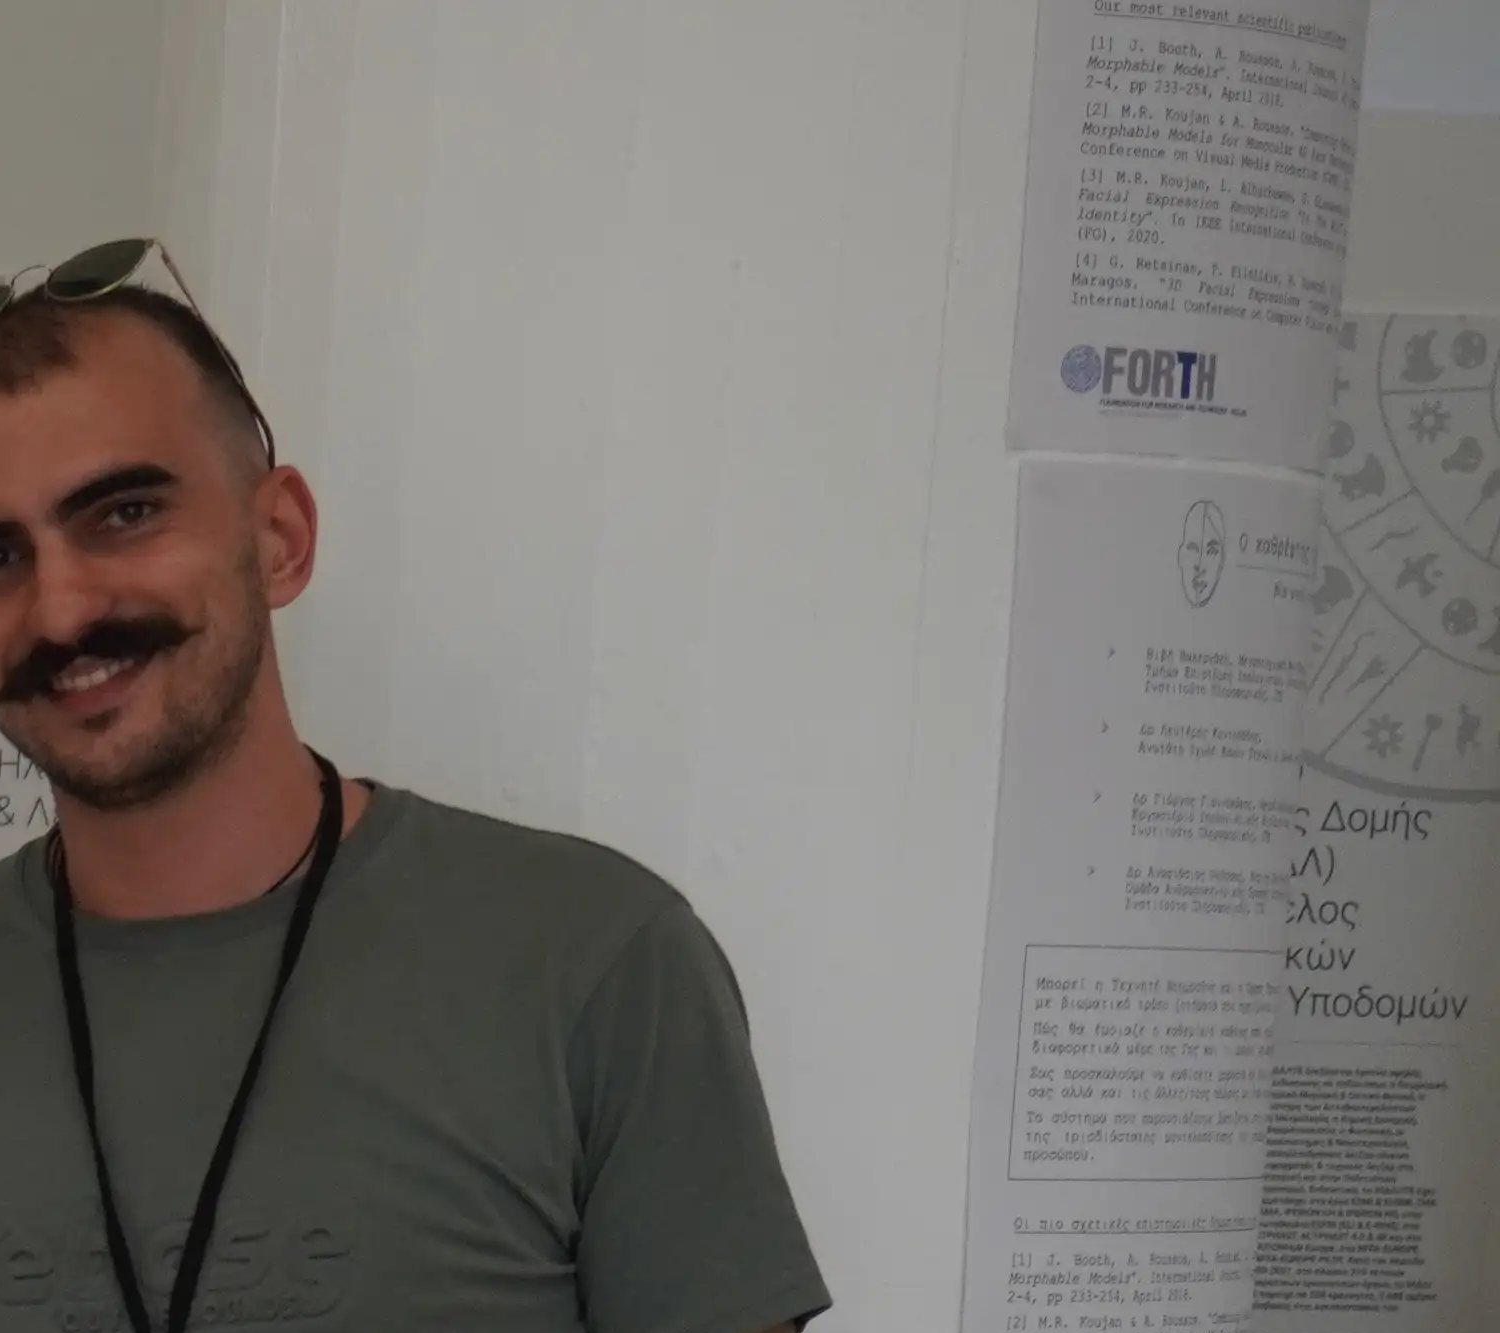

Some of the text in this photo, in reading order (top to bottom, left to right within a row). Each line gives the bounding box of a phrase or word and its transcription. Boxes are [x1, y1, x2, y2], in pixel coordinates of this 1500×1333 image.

[1094, 0, 1229, 22] Our most relevant
[1086, 56, 1164, 74] Morphable
[1129, 79, 1252, 103] pp April
[1121, 104, 1210, 125] M.R. Koujan
[1081, 122, 1213, 143] Morphable Models
[1080, 142, 1235, 166] Conference on Visual
[1116, 170, 1210, 192] M.R. Koujan,
[1078, 188, 1219, 210] Facial Expression
[1171, 214, 1185, 227] In
[1127, 229, 1165, 245] 2020.
[1071, 291, 1175, 311] International
[1102, 345, 1217, 401] FORTH
[1320, 801, 1432, 840] Δομής
[1288, 984, 1468, 1025] Υποδομών
[1012, 1253, 1116, 1268] [1] Booth,
[1009, 1272, 1080, 1287] Morphable
[1046, 1289, 1162, 1306] pp April
[1007, 1314, 1123, 1331] [2] M.R. Koujan
